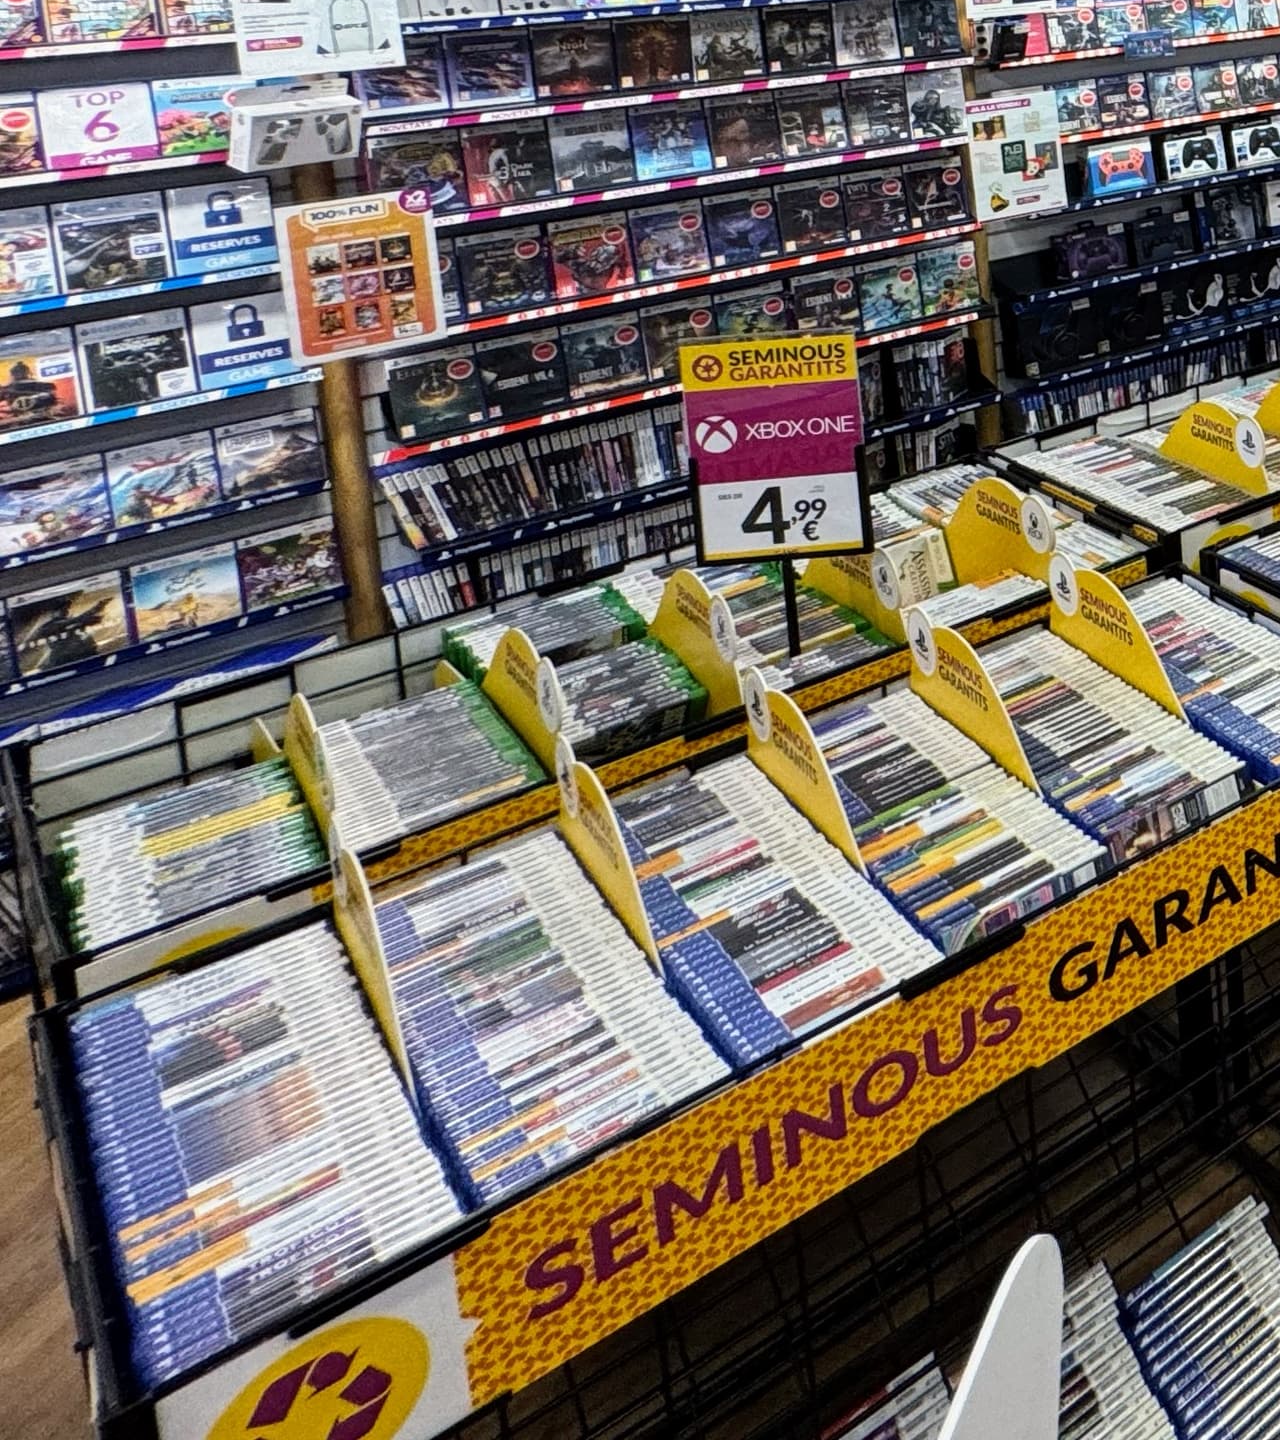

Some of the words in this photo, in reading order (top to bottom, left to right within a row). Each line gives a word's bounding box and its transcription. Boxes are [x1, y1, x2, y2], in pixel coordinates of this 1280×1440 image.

[68, 91, 125, 109] TOP
[84, 110, 120, 143] 6
[310, 209, 348, 221] 100%
[350, 203, 379, 216] FUN
[191, 235, 262, 252] RESERVES
[206, 253, 251, 268] GAME
[214, 347, 284, 367] RESERVES
[728, 343, 846, 367] SEMINOUS
[729, 360, 846, 382] GARANTITS
[745, 420, 806, 440] XBOX
[808, 415, 855, 435] ONE
[1191, 425, 1235, 452] GARANTITS
[1192, 414, 1233, 438] SEMINOUS
[977, 490, 1019, 519] SEMINOUS
[976, 504, 1021, 536] GARANTITS
[1079, 588, 1128, 626] SEMINOUS
[1081, 605, 1134, 646] GARANTITS
[938, 647, 983, 690] SEMINOUS
[939, 665, 989, 712] GARANTITS
[525, 982, 1024, 1322] SEMINOUS
